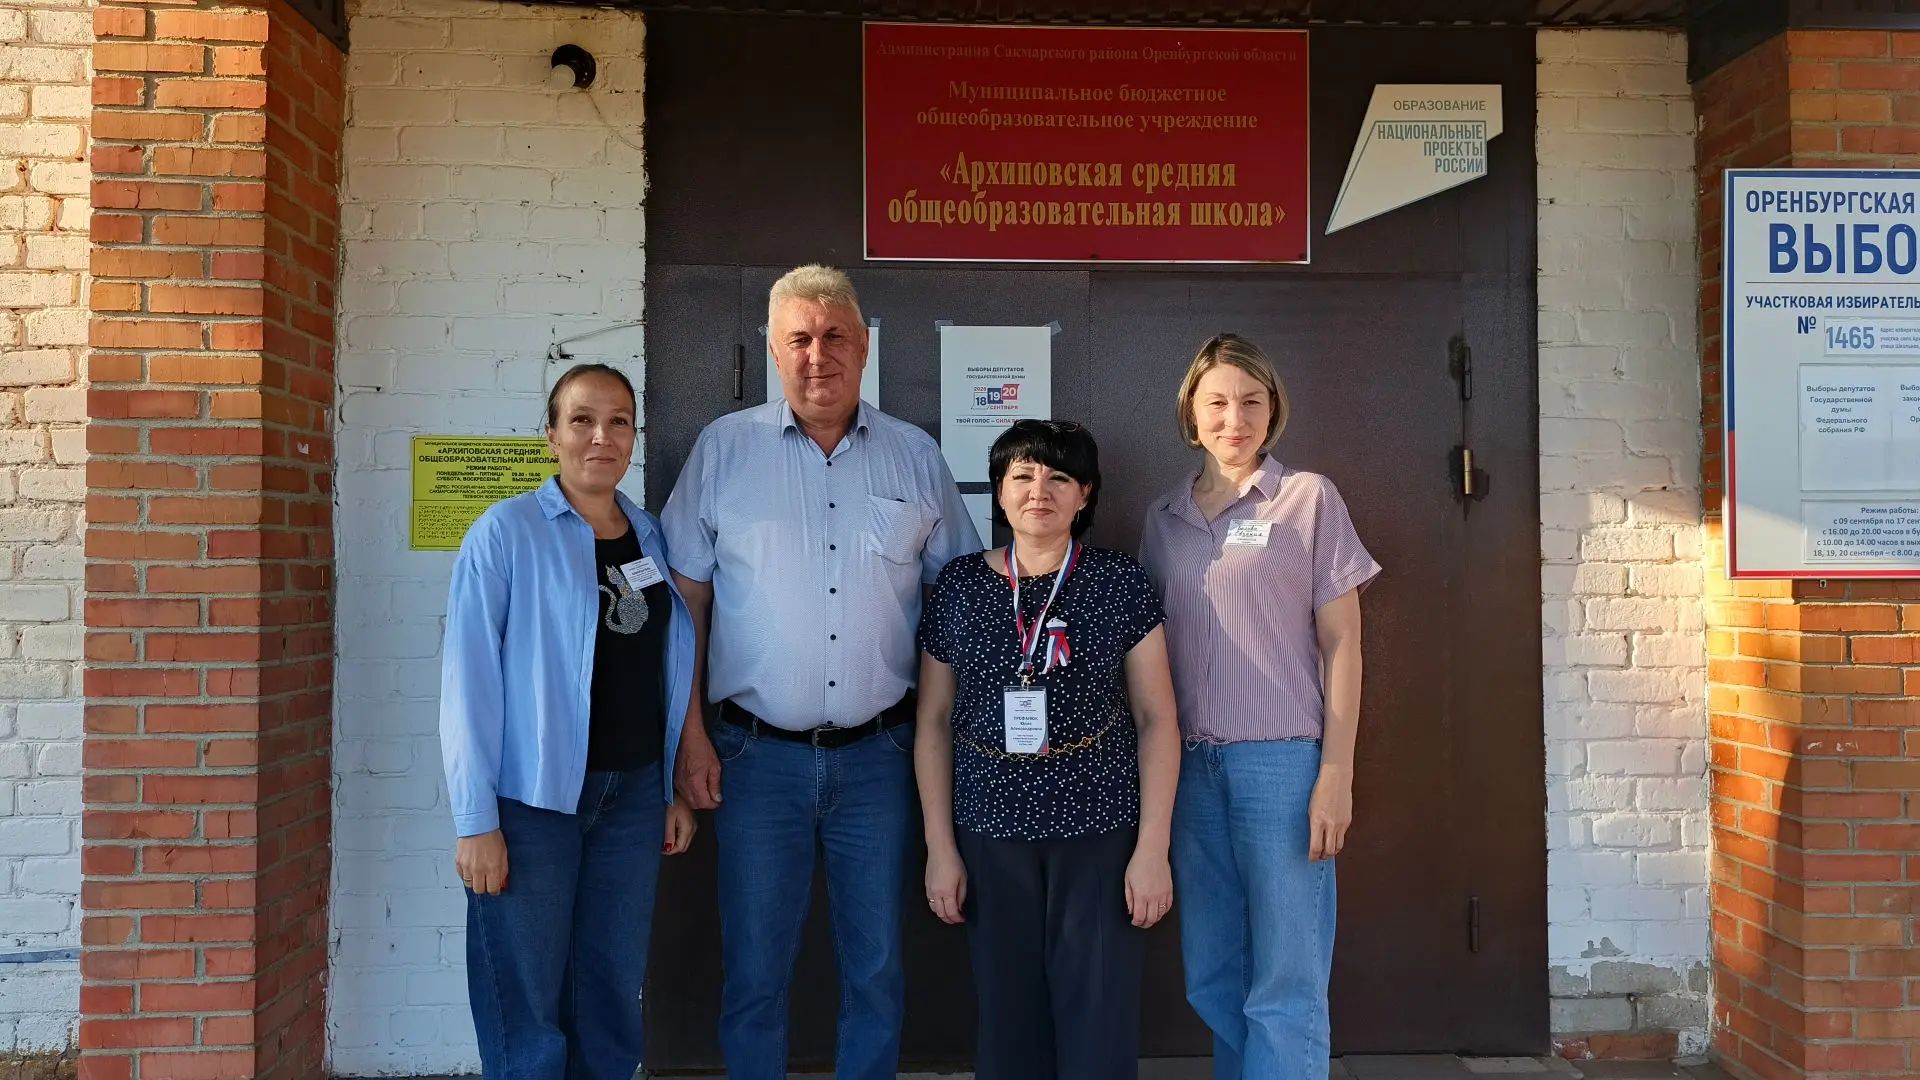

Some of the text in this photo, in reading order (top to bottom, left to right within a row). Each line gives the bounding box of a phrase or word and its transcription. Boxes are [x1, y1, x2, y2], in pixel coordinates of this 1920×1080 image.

[994, 44, 1085, 61] Сакмарского
[1089, 47, 1138, 63] района
[1142, 46, 1239, 64] Оренбургской
[1244, 48, 1297, 62] области
[948, 80, 1228, 104] Муниципальное бюджетное
[1393, 100, 1486, 111] ОБРАЗОВАНИЕ
[916, 106, 1258, 132] общеобразовательное учреждение
[1377, 124, 1483, 141] НАЦИОНАЛЬНЫЕ
[1423, 141, 1483, 157] ПРОЕКТЫ
[1435, 158, 1484, 173] РОССИИ
[939, 150, 1237, 194] «Архиповская средняя
[1745, 190, 1915, 214] ОРЕНБУРГСКАЯ
[887, 188, 1287, 231] общеобразовательная школа»
[1768, 222, 1918, 275] ВЫБО
[1746, 295, 1833, 309] УЧАСТКОВАЯ
[1797, 315, 1875, 350] № 1465
[1002, 387, 1017, 397] 20
[1806, 385, 1838, 393] Выборы
[975, 396, 987, 406] 18
[989, 391, 1000, 401] 19
[1809, 396, 1873, 404] Государственной
[1818, 426, 1853, 434] собрания
[437, 447, 541, 456] «АРХИПОВСКАЯ СРЕДНЯЯ
[418, 455, 525, 463] ОБЩЕОБРАЗОВАТЕЛЬНАЯ
[1889, 506, 1919, 514] работы:
[1849, 517, 1884, 526] сентября
[1849, 529, 1860, 537] до
[1813, 549, 1825, 557] 18,
[1826, 549, 1838, 557] 19,
[1849, 549, 1884, 558] сентября
